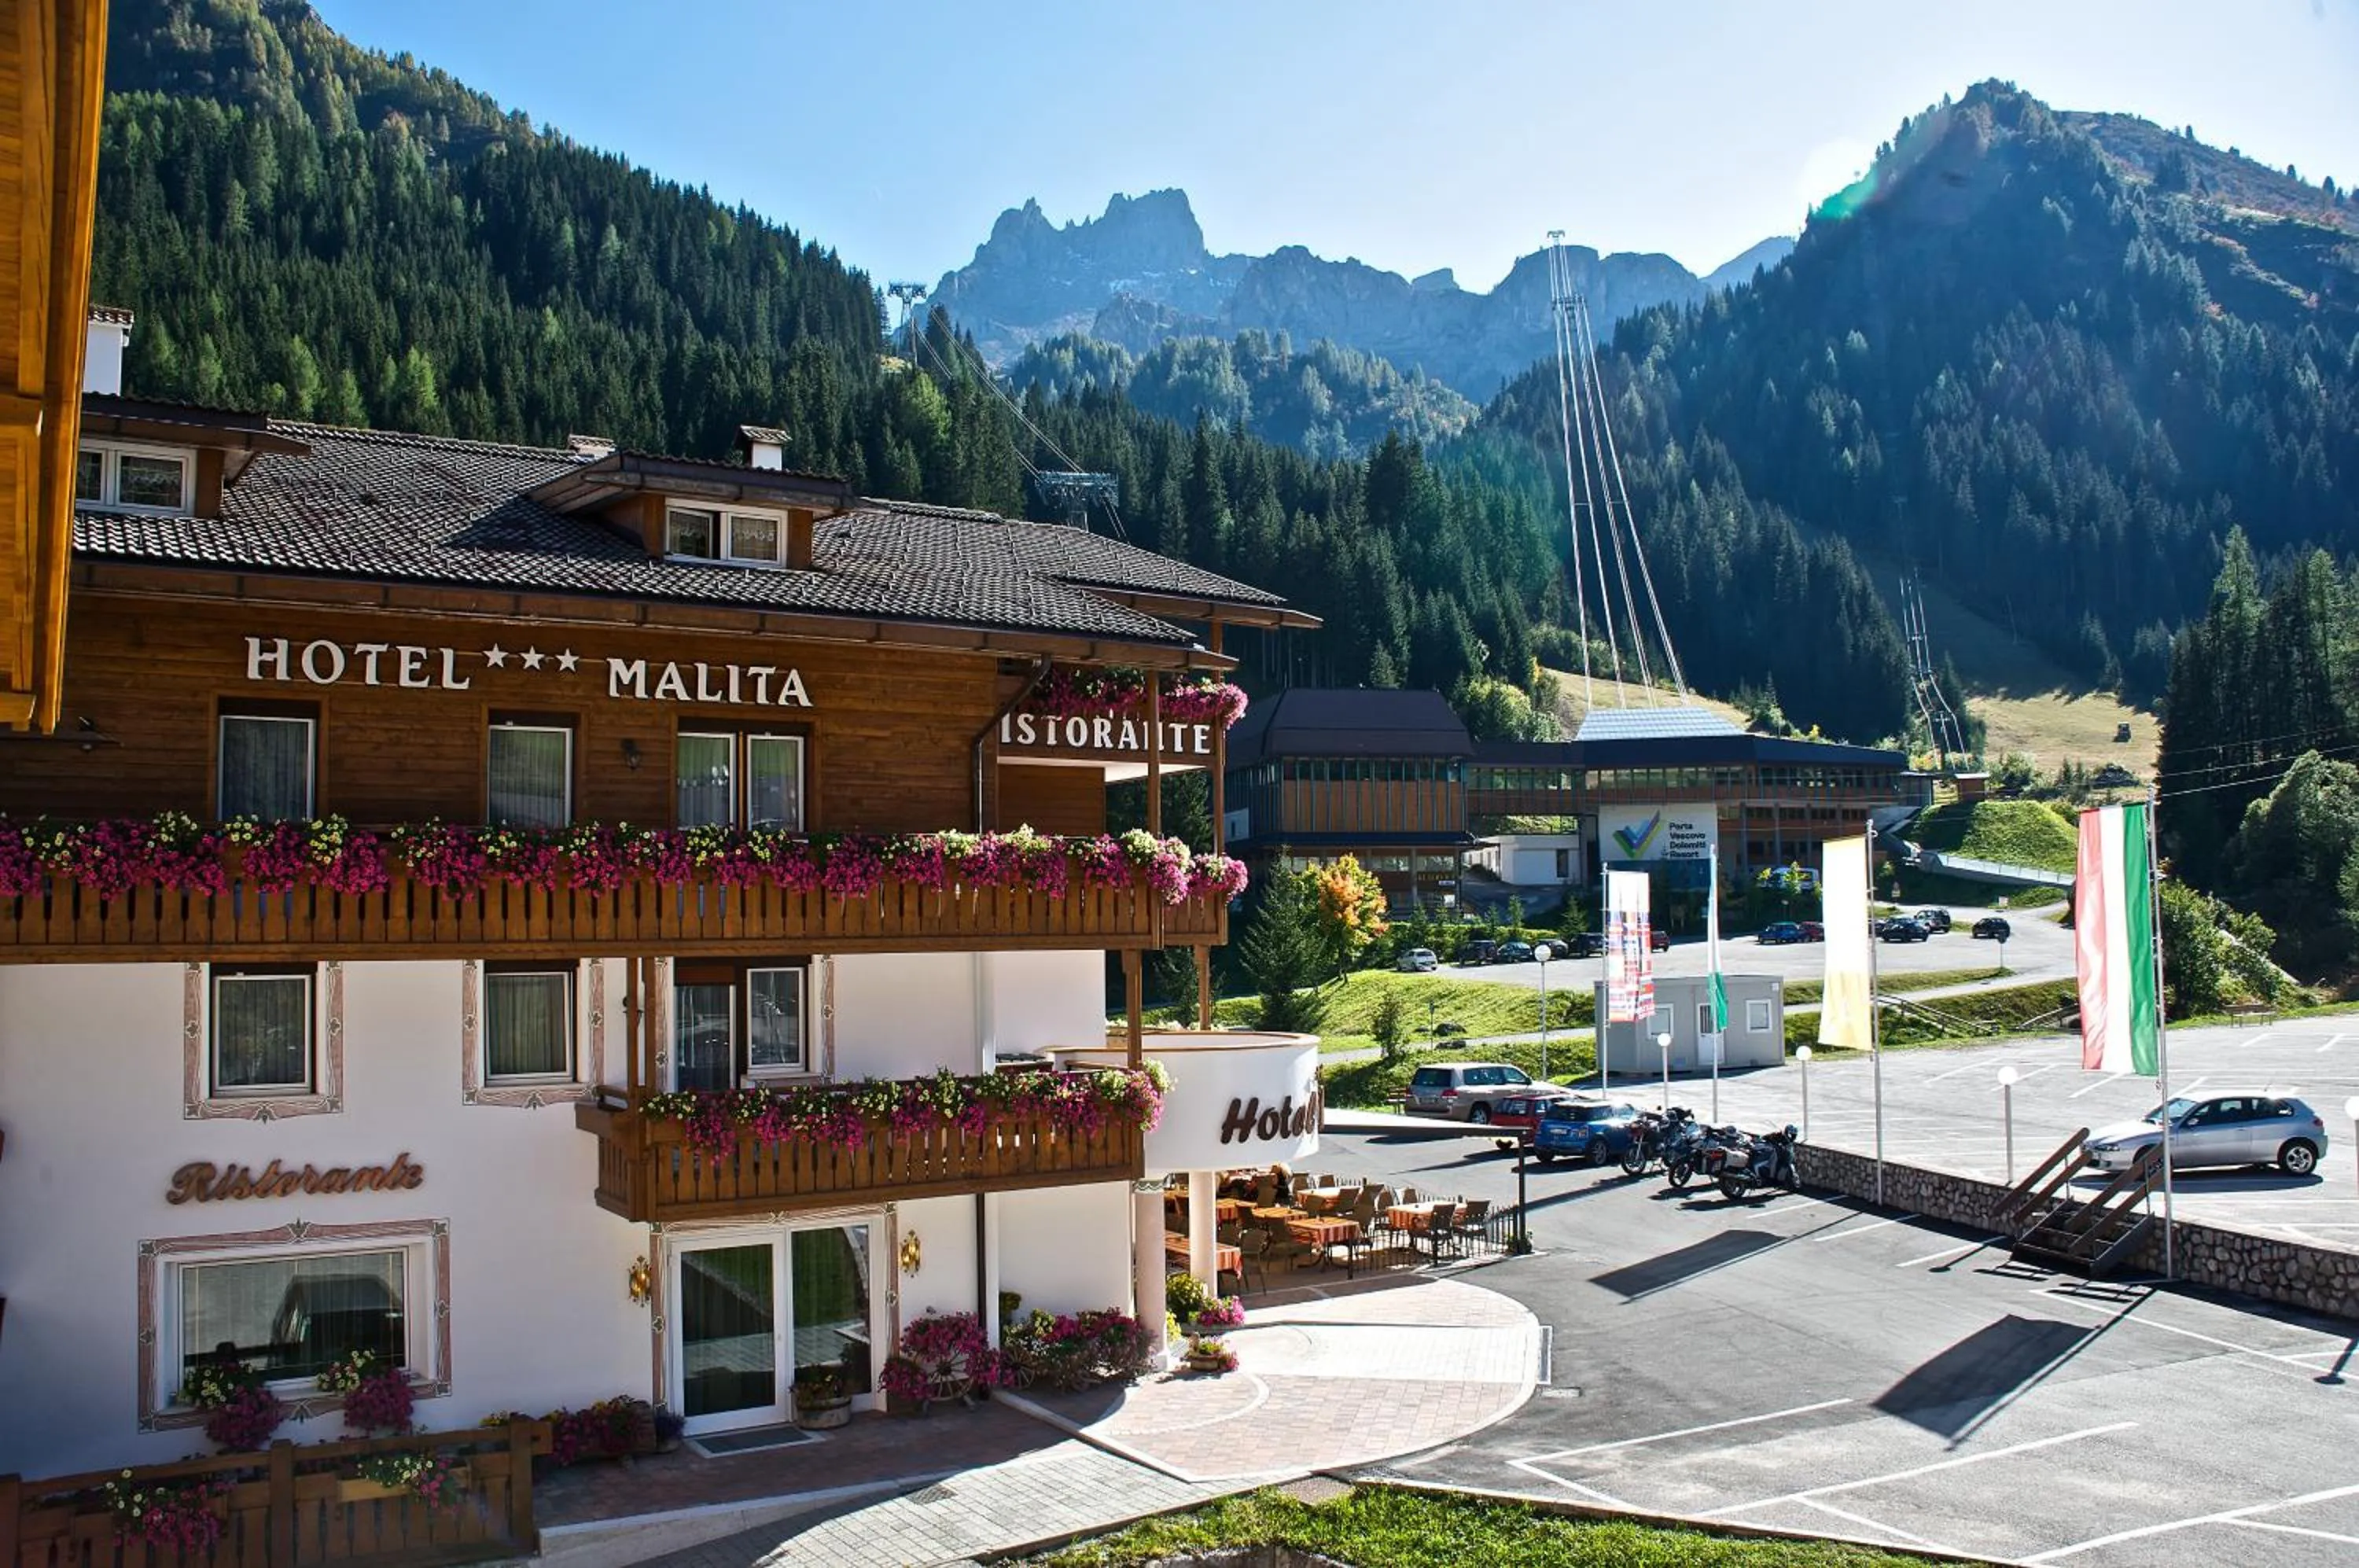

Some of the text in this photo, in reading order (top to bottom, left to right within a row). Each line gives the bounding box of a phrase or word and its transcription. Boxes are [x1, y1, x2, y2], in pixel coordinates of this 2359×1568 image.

[245, 636, 813, 706] HOTEL MALITA
[1669, 841, 1706, 849] Dolomiti
[1220, 1091, 1318, 1145] Hotel
[166, 1152, 425, 1205] Ristorante
